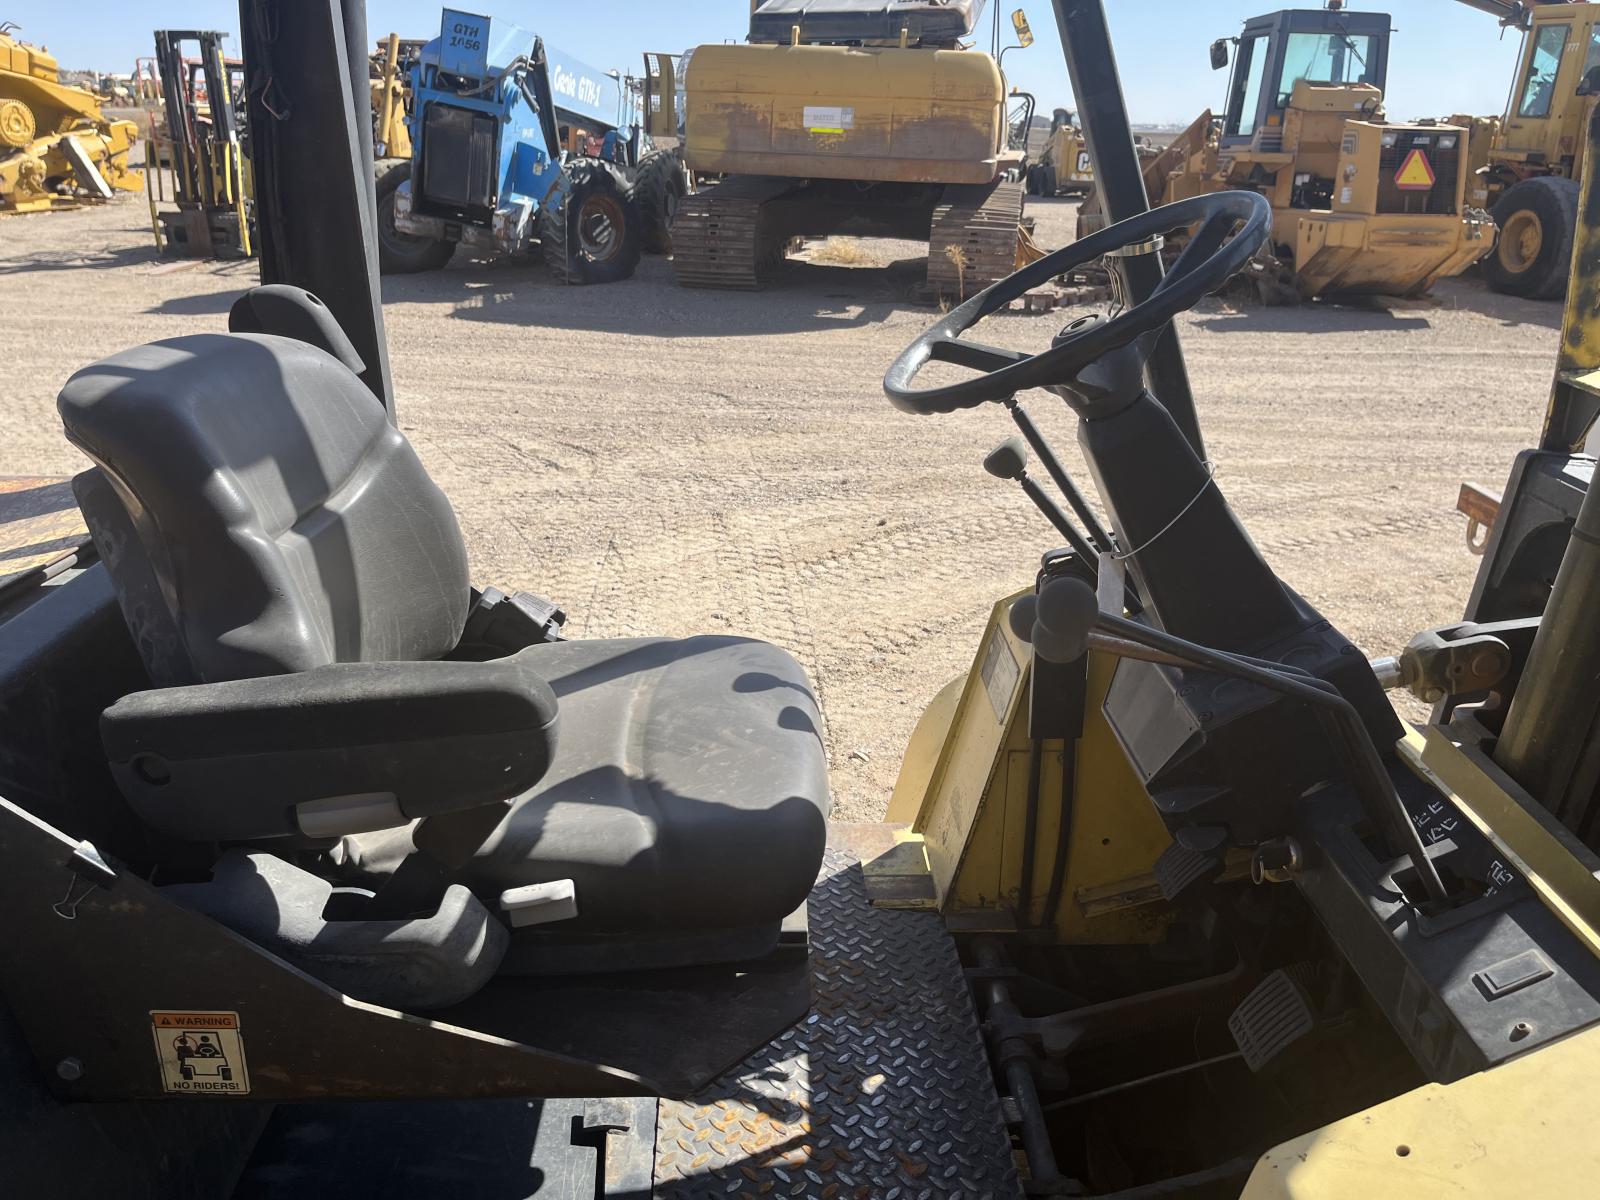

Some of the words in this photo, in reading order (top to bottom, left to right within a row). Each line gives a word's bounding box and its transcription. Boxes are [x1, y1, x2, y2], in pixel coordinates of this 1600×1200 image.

[453, 23, 480, 37] GTH
[554, 64, 576, 97] Genie
[175, 1017, 231, 1026] WARNING
[173, 1081, 190, 1090] NO
[193, 1082, 240, 1090] RIDERS!
